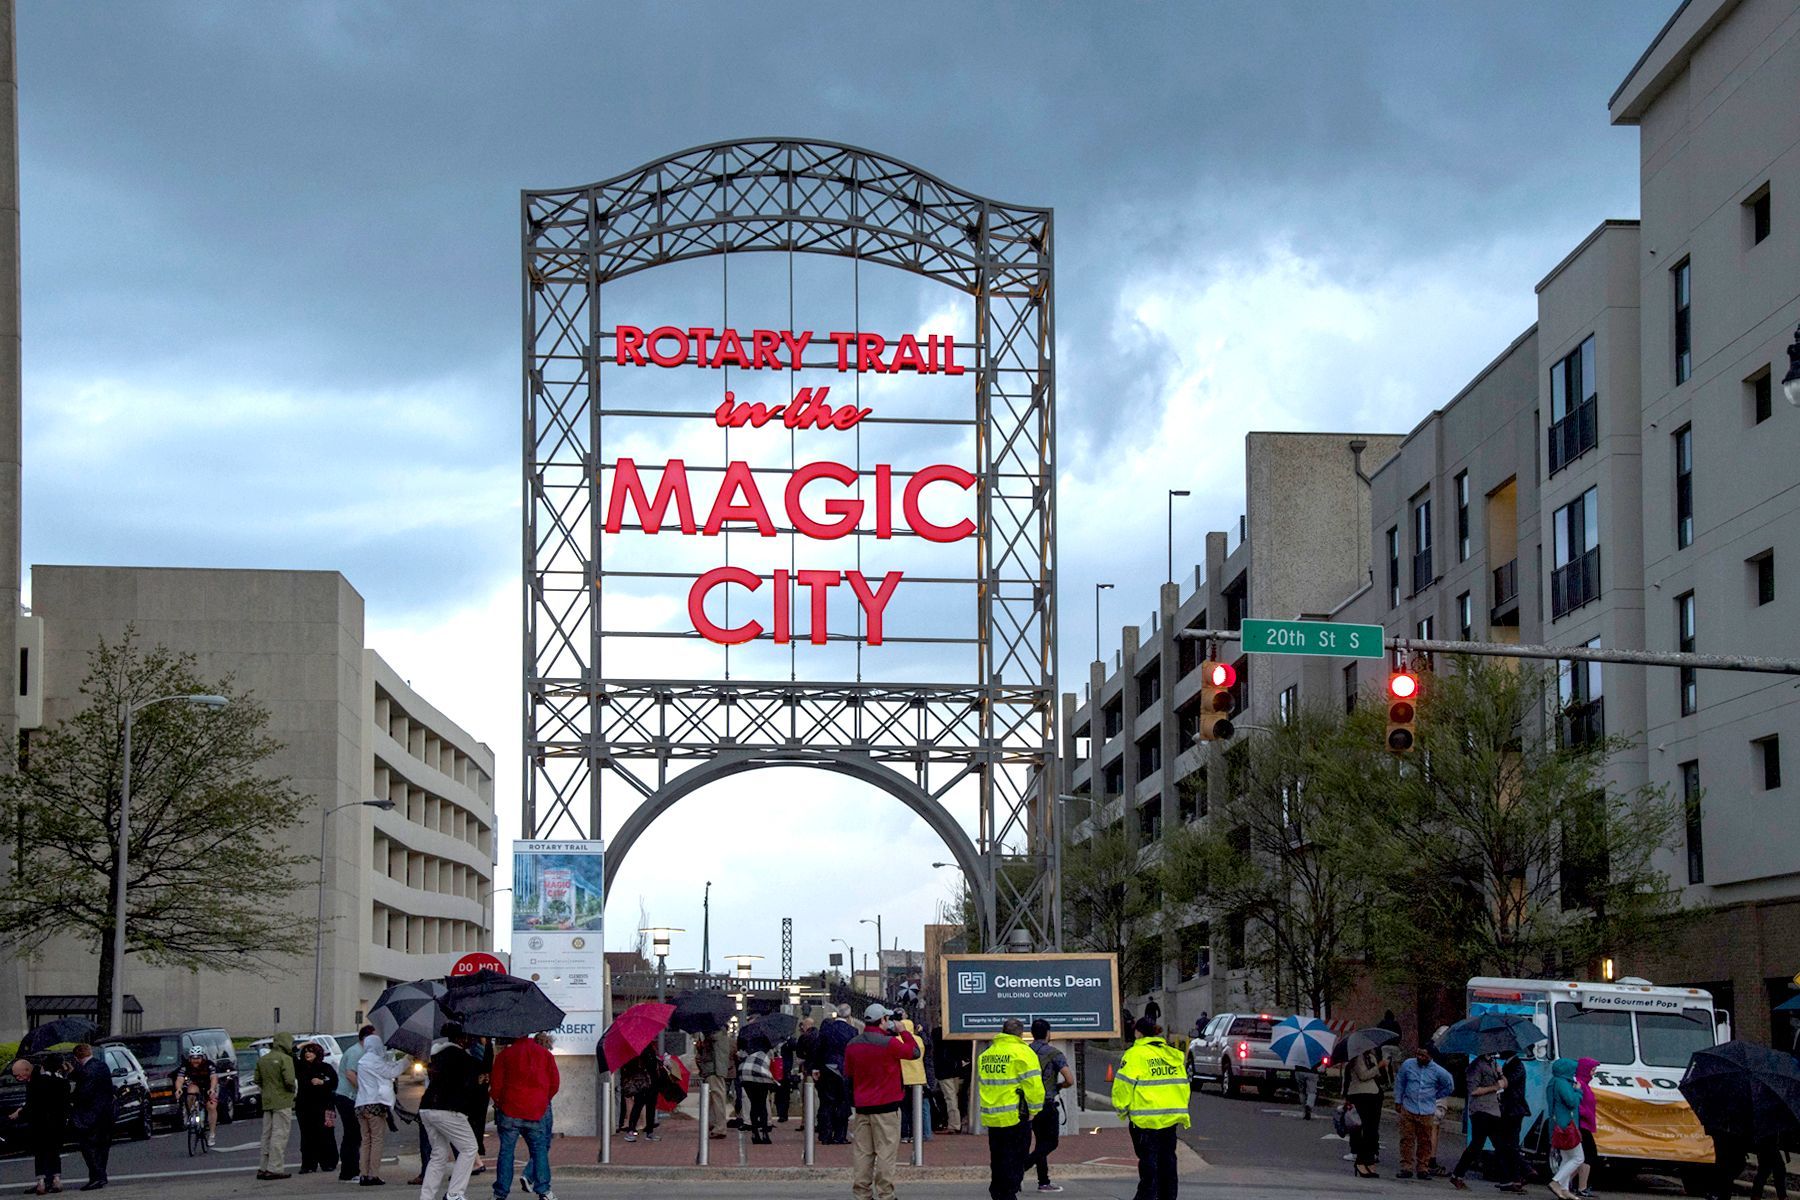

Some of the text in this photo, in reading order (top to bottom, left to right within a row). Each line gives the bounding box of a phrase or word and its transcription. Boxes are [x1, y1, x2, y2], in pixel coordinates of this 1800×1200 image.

[615, 325, 965, 376] ROTARY TRAIL
[715, 386, 873, 431] in the
[605, 457, 978, 543] MAGIC
[687, 565, 905, 646] CITY
[1266, 628, 1360, 649] 20th St S
[528, 843, 562, 851] ROTARY
[458, 962, 500, 972] DO NOT
[994, 975, 1101, 988] Clements Dean
[1588, 996, 1678, 1008] Frios Gourmet Pops
[548, 1023, 596, 1035] ARBERT
[981, 1064, 1007, 1074] POLICE
[1151, 1066, 1178, 1078] POLICE
